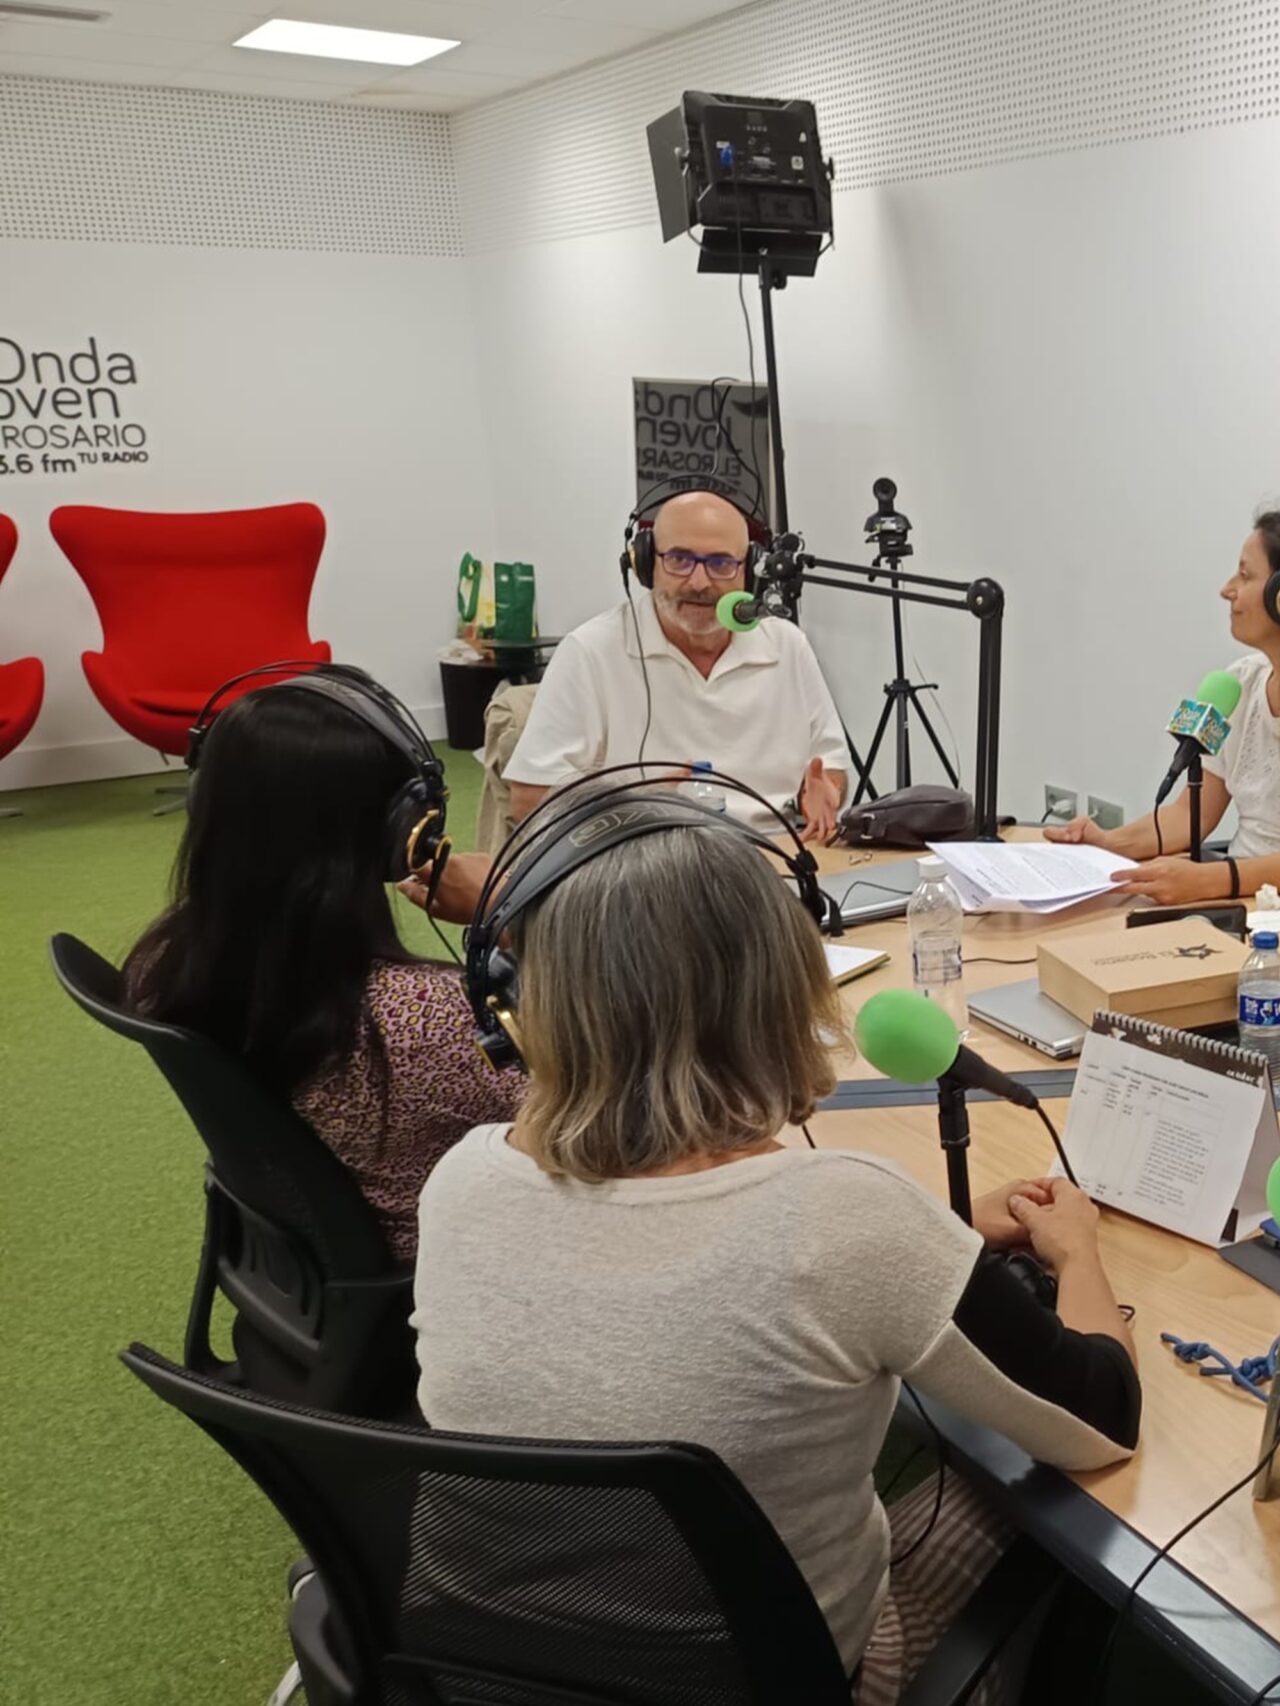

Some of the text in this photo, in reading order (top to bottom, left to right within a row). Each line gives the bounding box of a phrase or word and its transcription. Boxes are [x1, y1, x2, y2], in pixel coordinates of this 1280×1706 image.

[1, 423, 146, 449] ROSARIO
[41, 453, 77, 473] fm
[78, 452, 98, 464] TU
[101, 451, 149, 464] RADIO
